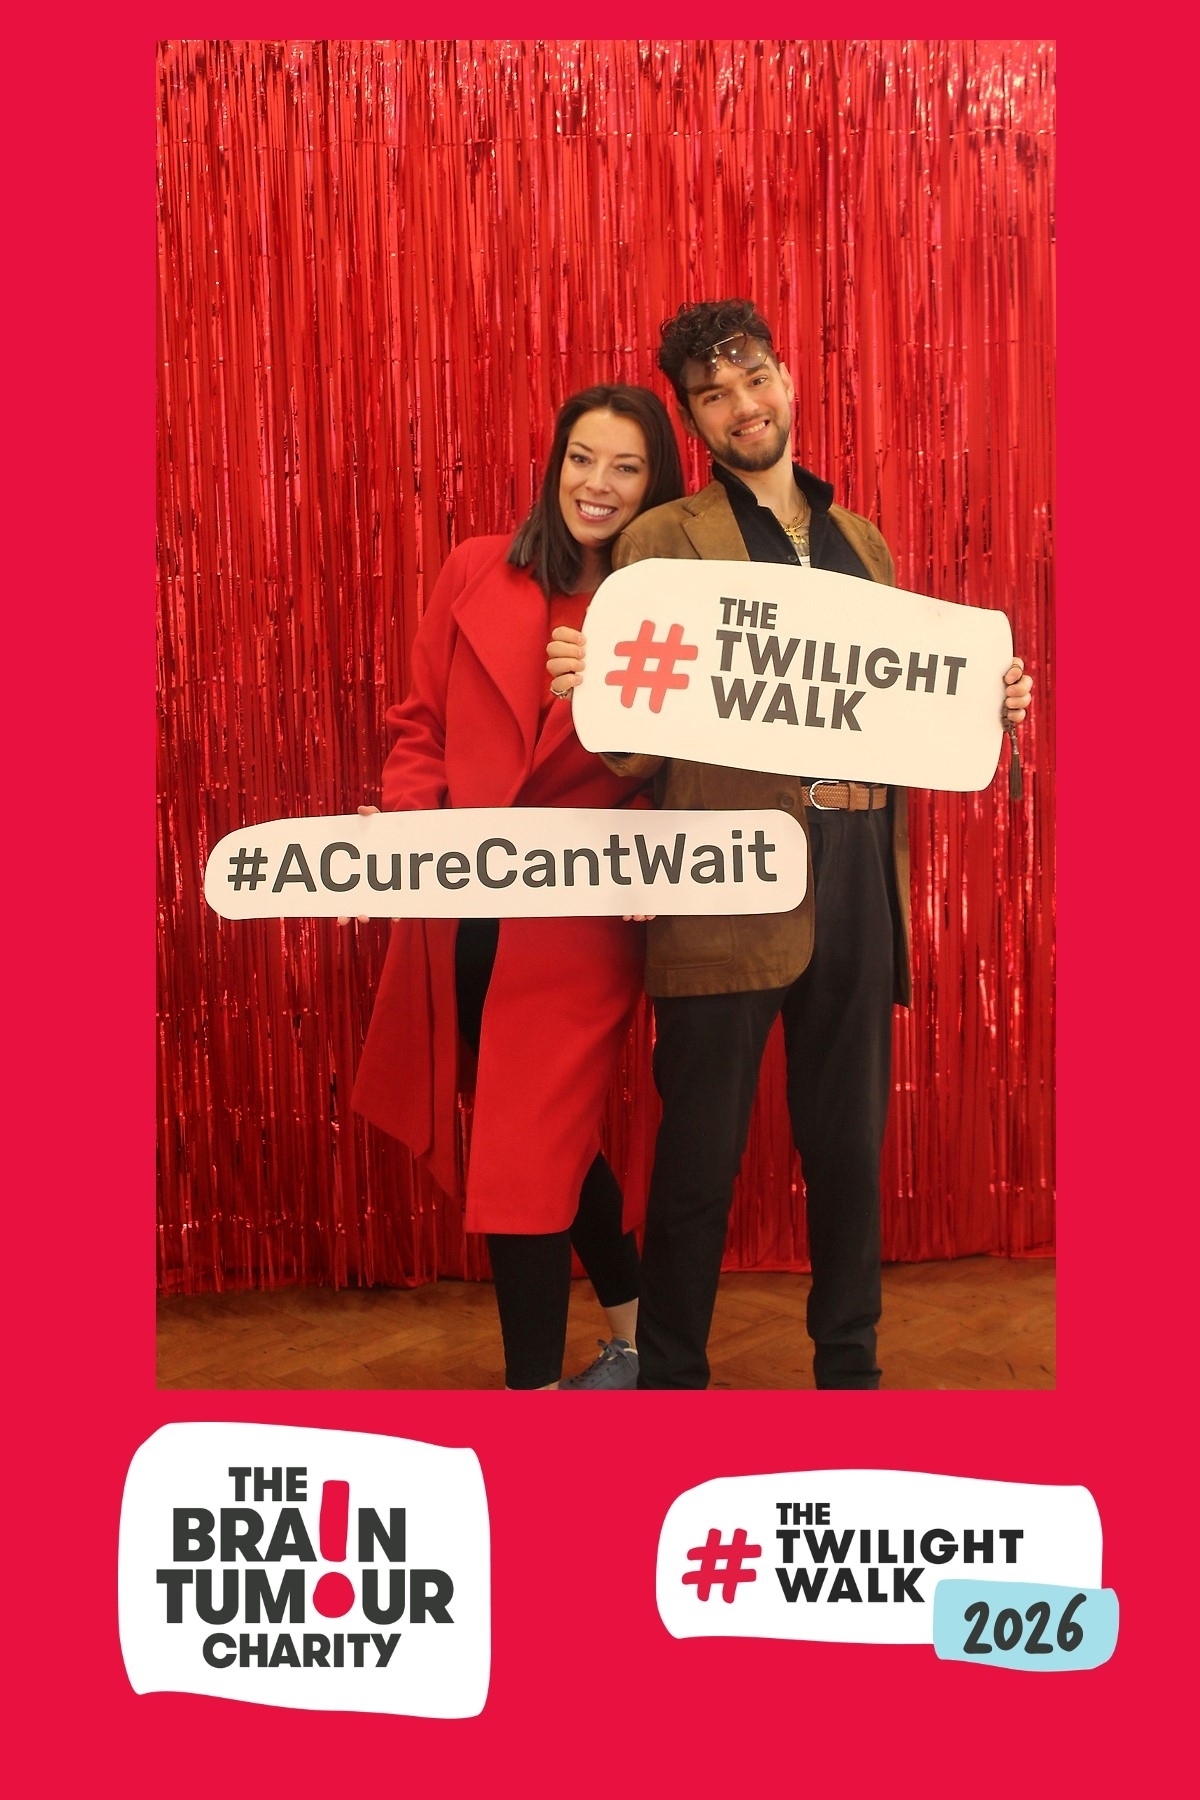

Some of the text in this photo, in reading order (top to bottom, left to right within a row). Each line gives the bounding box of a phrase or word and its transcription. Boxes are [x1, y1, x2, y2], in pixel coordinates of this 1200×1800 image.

[719, 597, 778, 631] THE
[716, 629, 967, 696] TWILIGHT
[711, 676, 867, 732] WALK
[227, 829, 778, 893] #ACureCantWait
